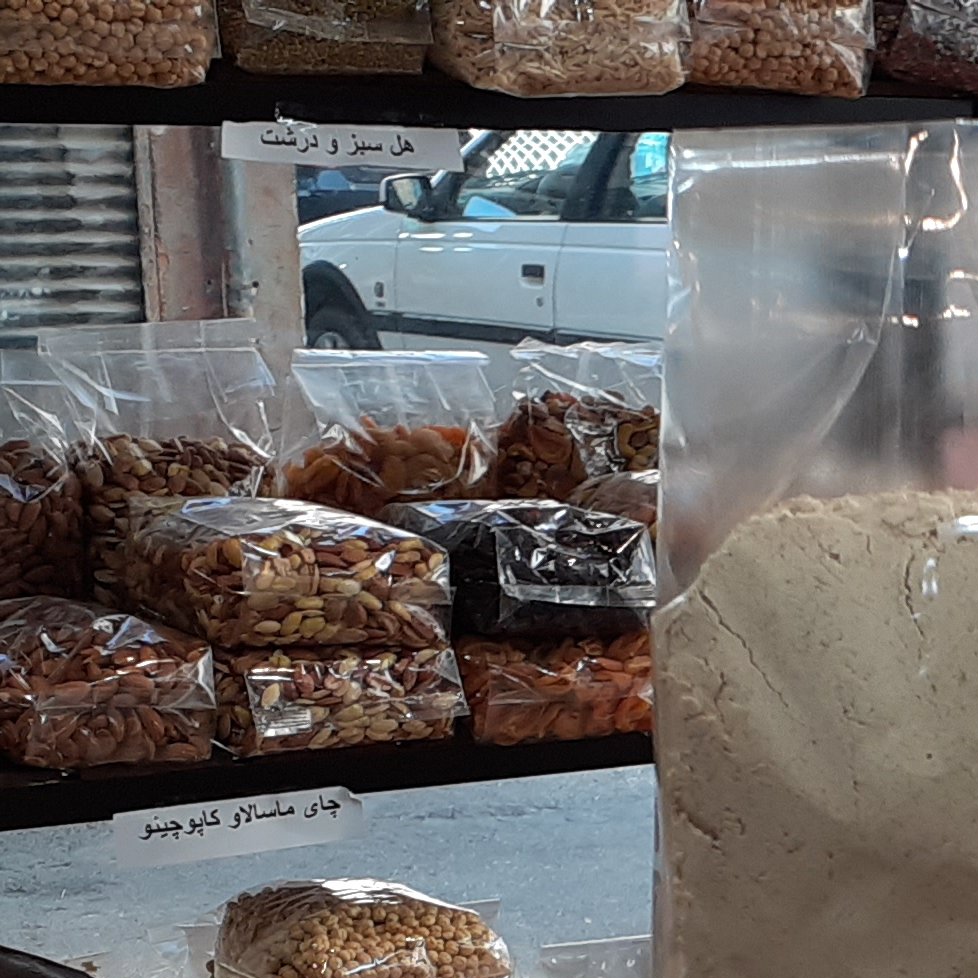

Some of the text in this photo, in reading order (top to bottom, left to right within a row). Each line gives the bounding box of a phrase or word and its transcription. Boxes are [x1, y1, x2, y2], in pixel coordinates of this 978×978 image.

[260, 126, 415, 157] هل سبز و درشت
[303, 794, 342, 819] چای
[138, 808, 222, 840] کاپوچینو
